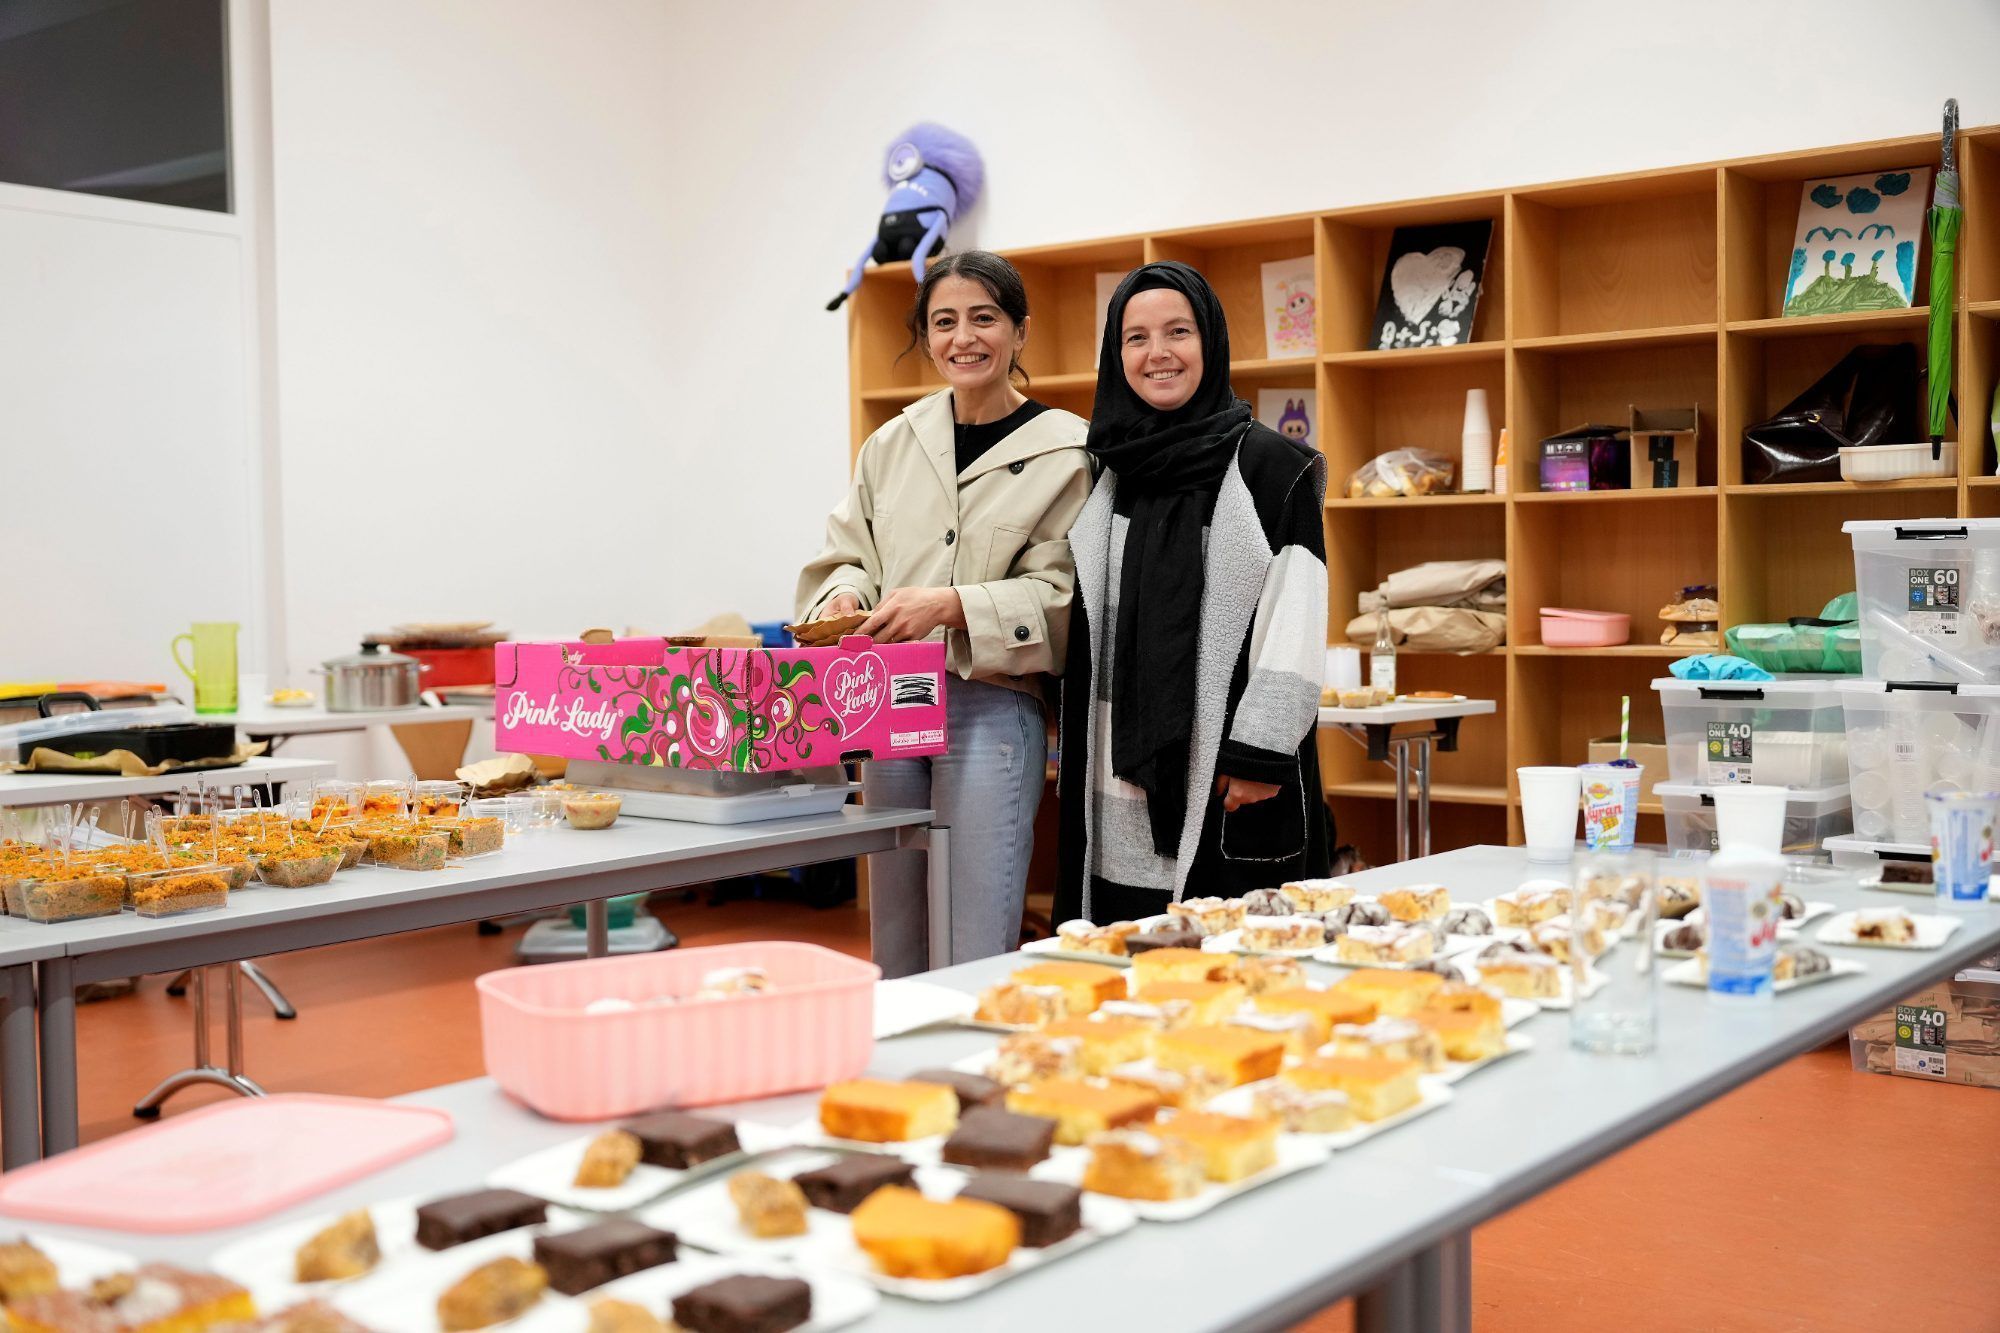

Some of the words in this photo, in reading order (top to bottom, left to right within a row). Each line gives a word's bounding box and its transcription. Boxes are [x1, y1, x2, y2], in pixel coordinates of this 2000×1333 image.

[1934, 570, 1958, 585] 60
[834, 660, 875, 700] Pink
[503, 691, 560, 730] Pink
[1728, 723, 1751, 738] 40
[1897, 1006, 1916, 1015] BOX
[1897, 1013, 1917, 1023] ONE
[1920, 1009, 1945, 1026] 40
